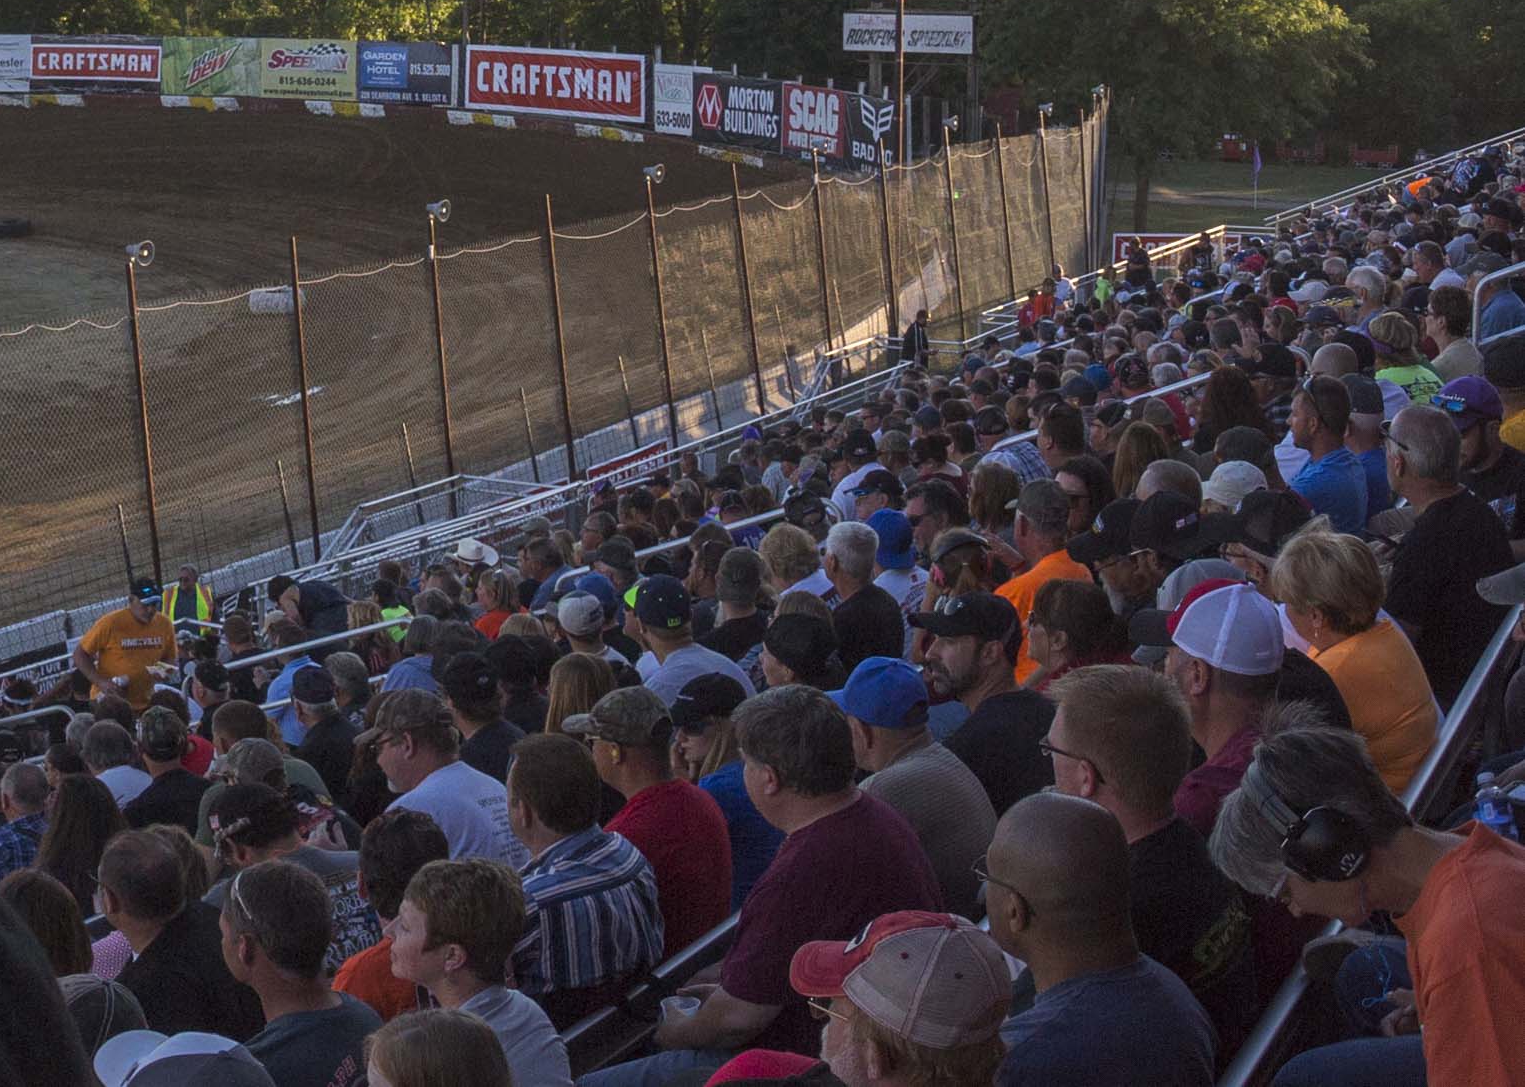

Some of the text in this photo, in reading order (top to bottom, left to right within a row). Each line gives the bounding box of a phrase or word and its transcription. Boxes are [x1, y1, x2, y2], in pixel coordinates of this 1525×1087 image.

[38, 53, 152, 72] CRAFTSMAN
[363, 51, 406, 61] GARDEN
[367, 65, 400, 75] HOTEL
[279, 76, 336, 86] 815-636-0244
[476, 61, 632, 104] CRAFTSMAN
[728, 86, 775, 113] MORTON
[656, 110, 691, 128] 633-5000
[789, 89, 840, 136] SCAG
[724, 109, 779, 139] BUILDINGS
[788, 130, 810, 147] POWER
[852, 141, 875, 161] BAD
